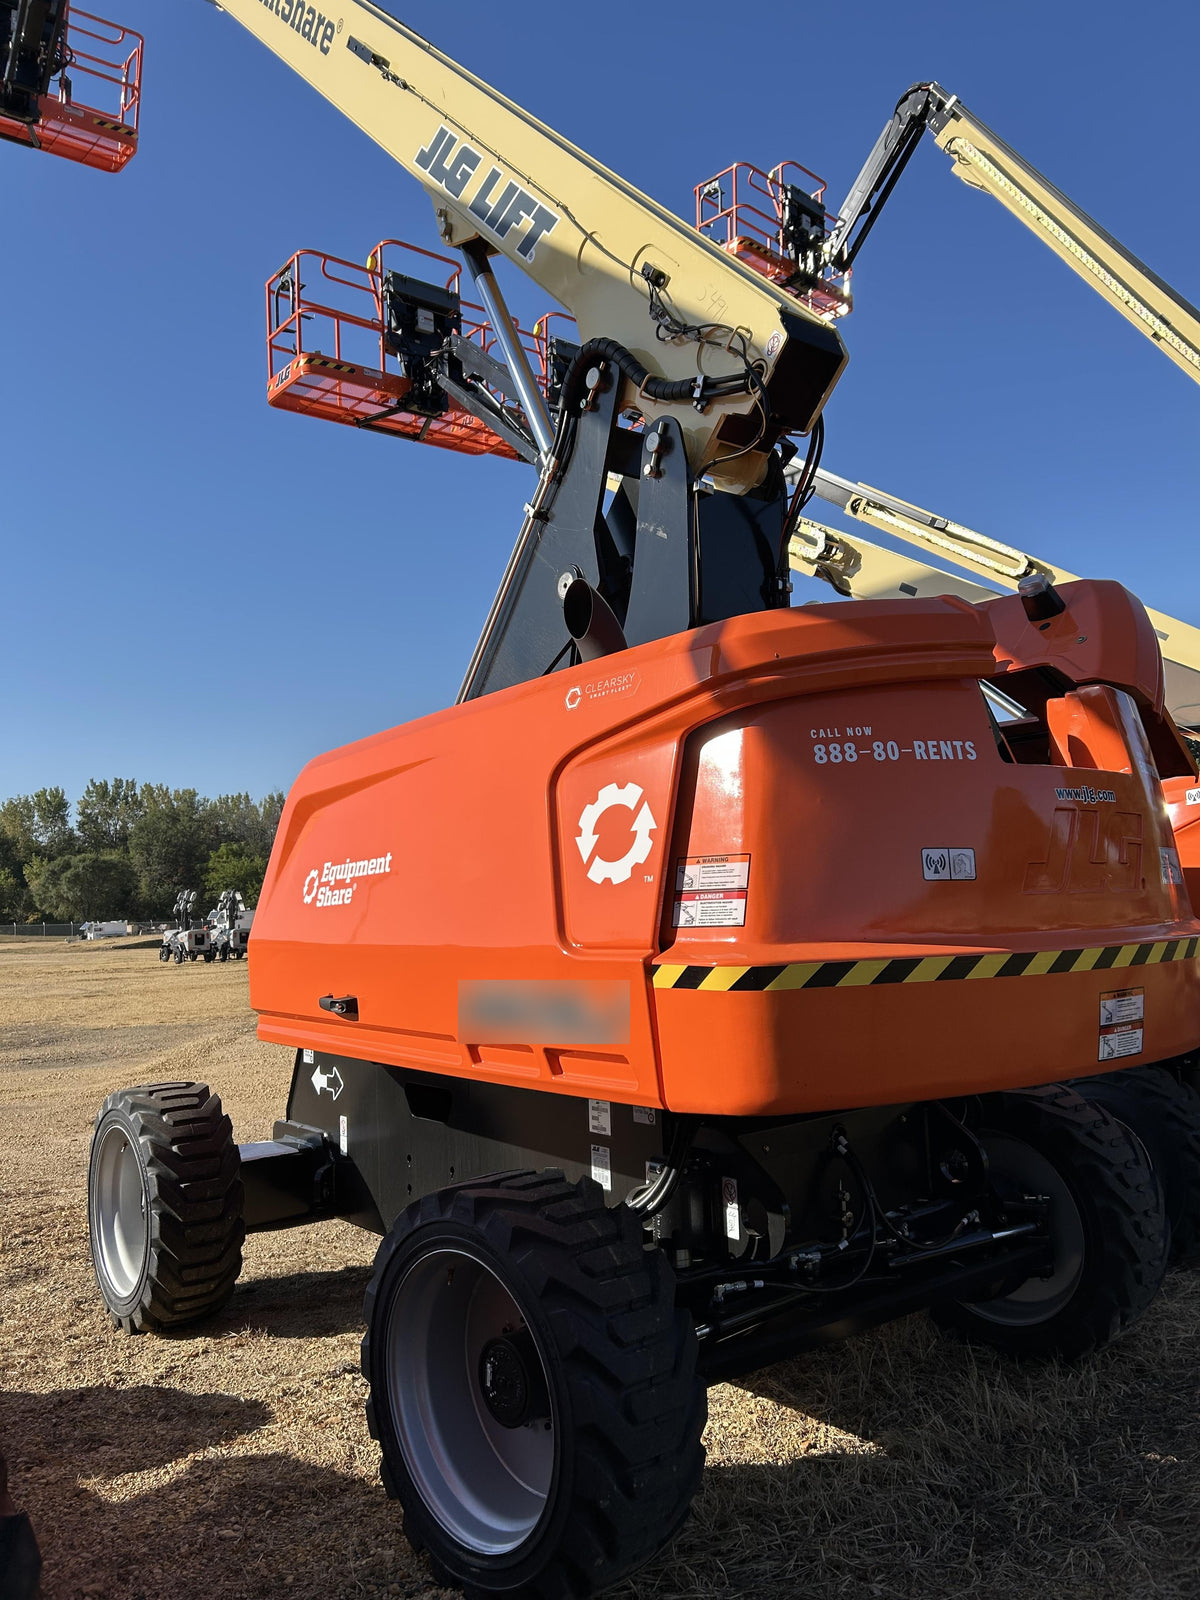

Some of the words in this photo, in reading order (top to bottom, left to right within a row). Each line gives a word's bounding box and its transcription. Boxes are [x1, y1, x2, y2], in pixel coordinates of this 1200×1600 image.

[413, 123, 484, 200] JLG
[467, 165, 561, 259] LIFT
[275, 365, 291, 389] JLG
[585, 672, 635, 694] CLEARSKY
[810, 729, 841, 739] CALL
[846, 726, 872, 736] NOW
[813, 740, 977, 764] 888-80-RENTS
[1055, 786, 1116, 804] www.jlg.com
[702, 856, 729, 864] WARNING
[1022, 807, 1144, 895] JLG
[320, 852, 393, 886] Equipment
[643, 875, 654, 883] TM
[316, 886, 353, 908] Share
